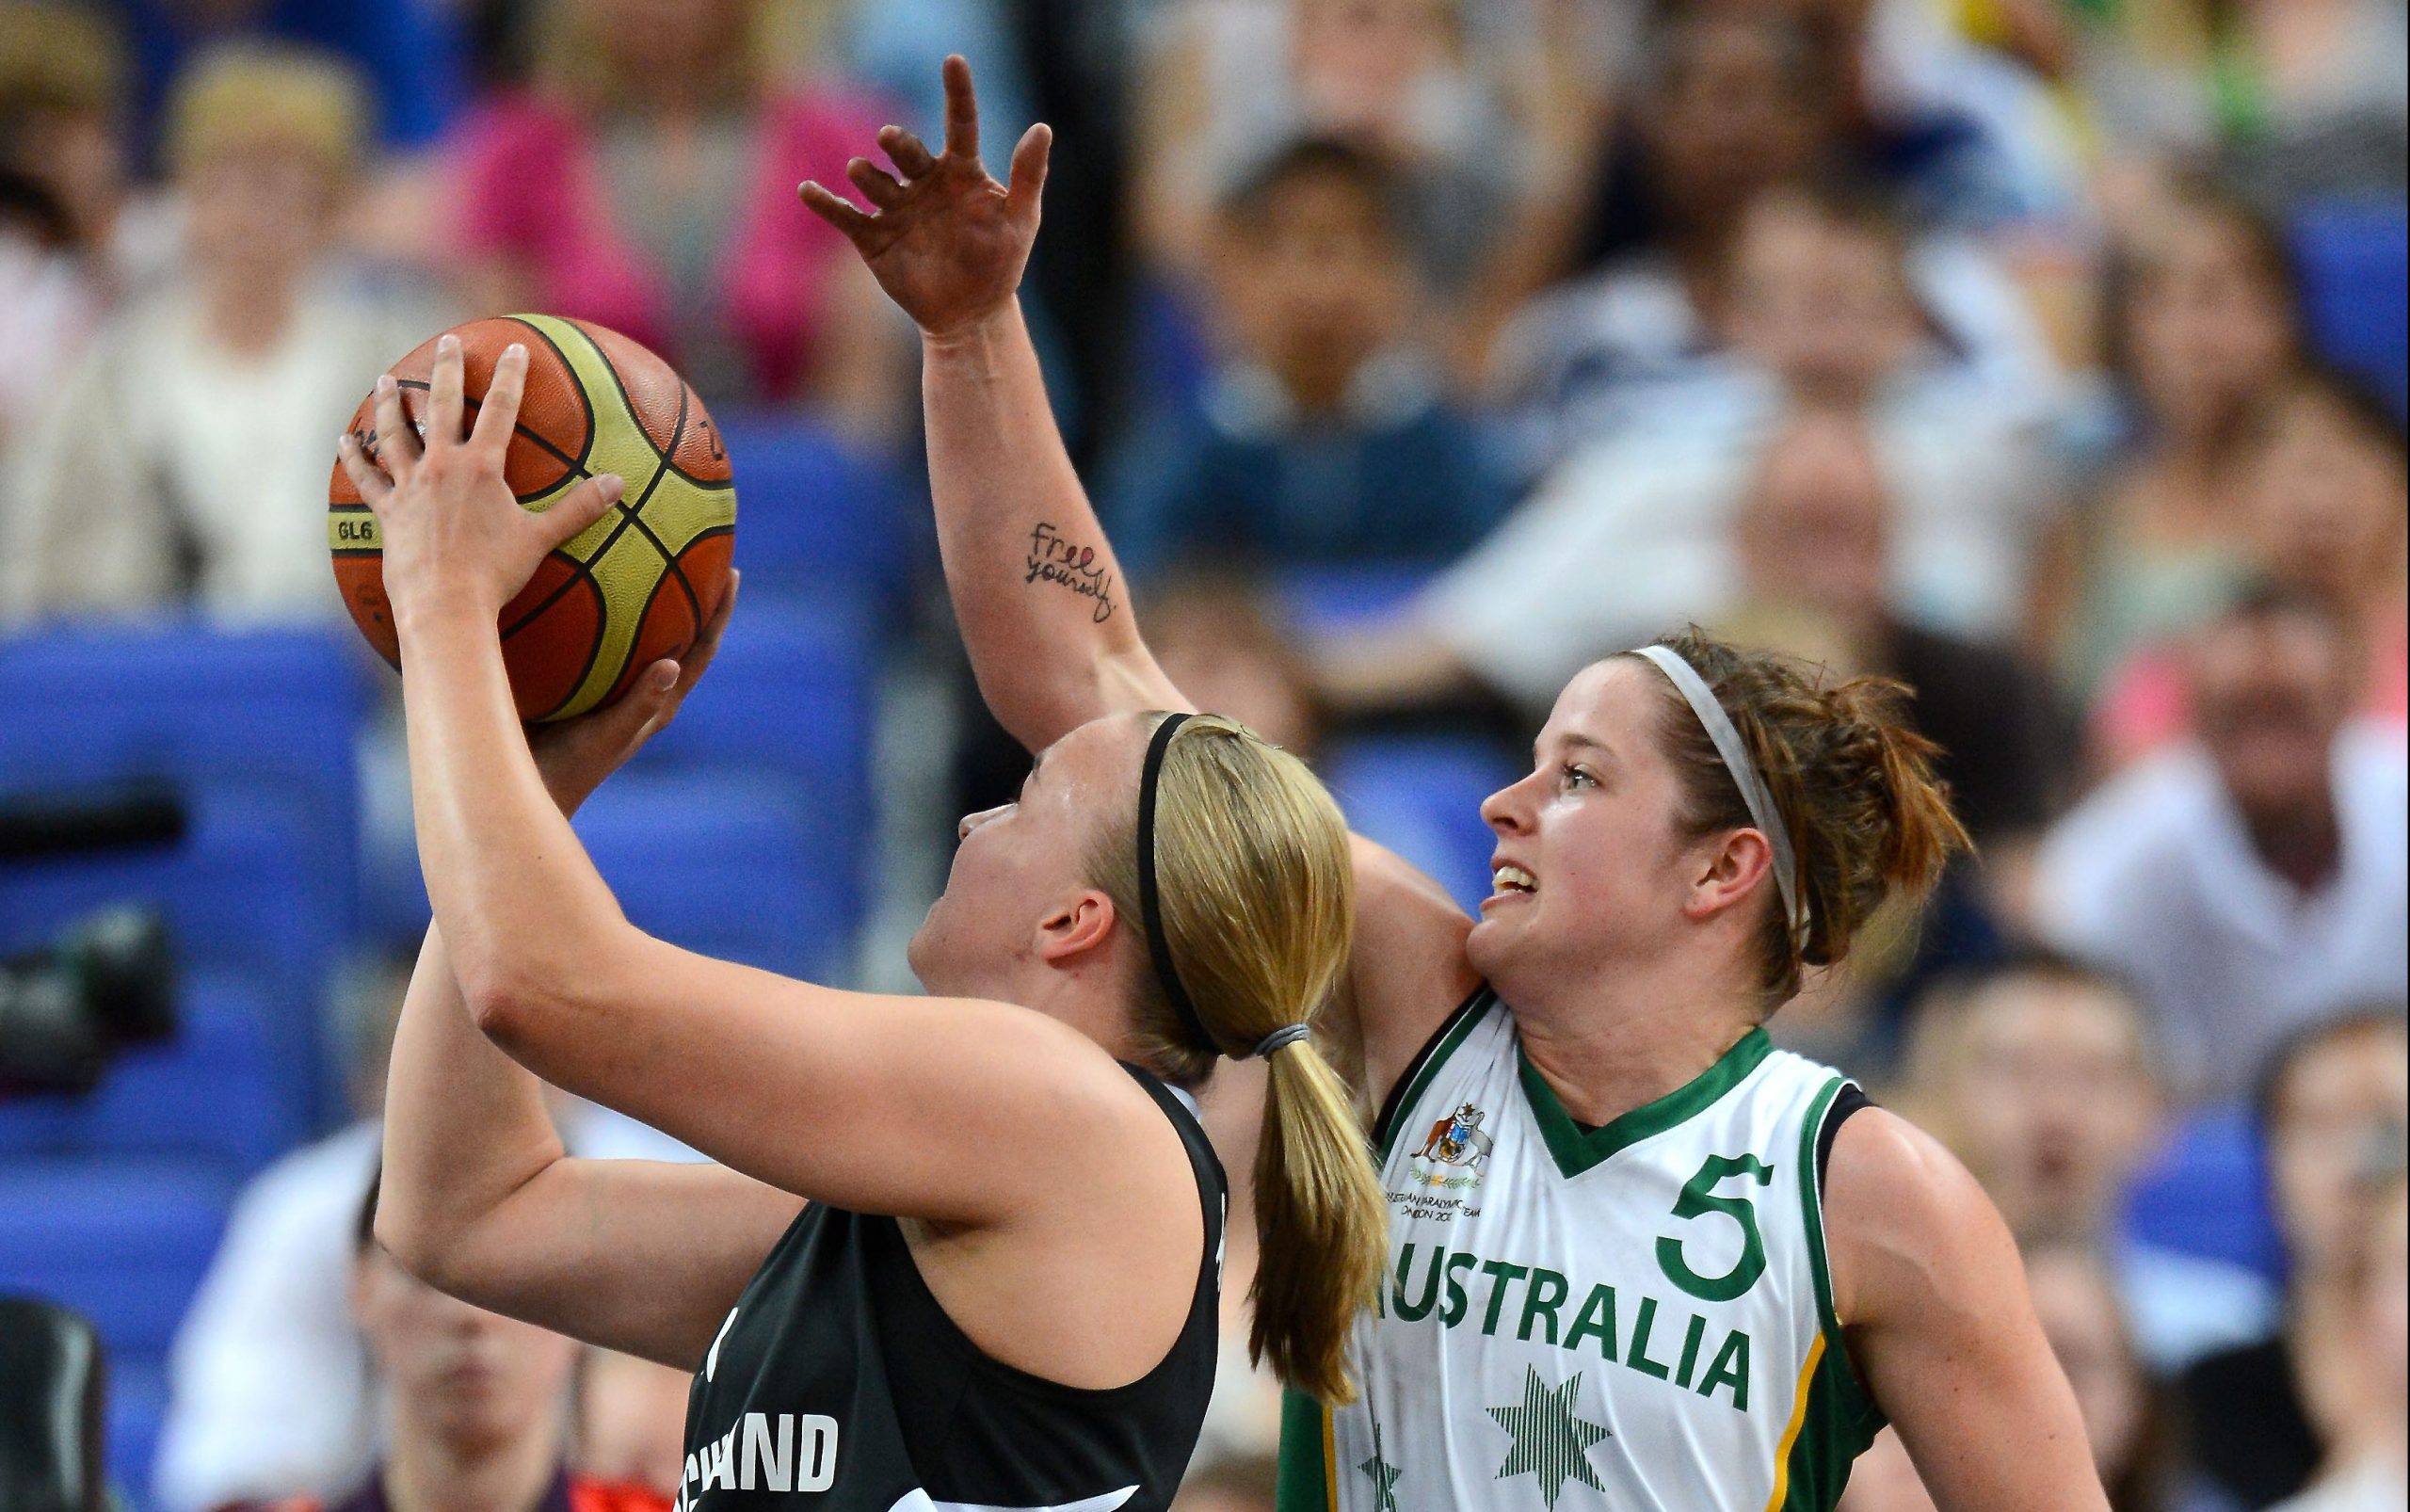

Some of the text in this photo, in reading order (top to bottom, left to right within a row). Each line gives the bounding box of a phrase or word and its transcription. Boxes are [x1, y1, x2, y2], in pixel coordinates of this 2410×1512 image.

[338, 521, 373, 540] GL6
[1031, 523, 1103, 577] Free
[1655, 1153, 1775, 1302] 5
[1377, 1243, 1750, 1412] USTRALIA
